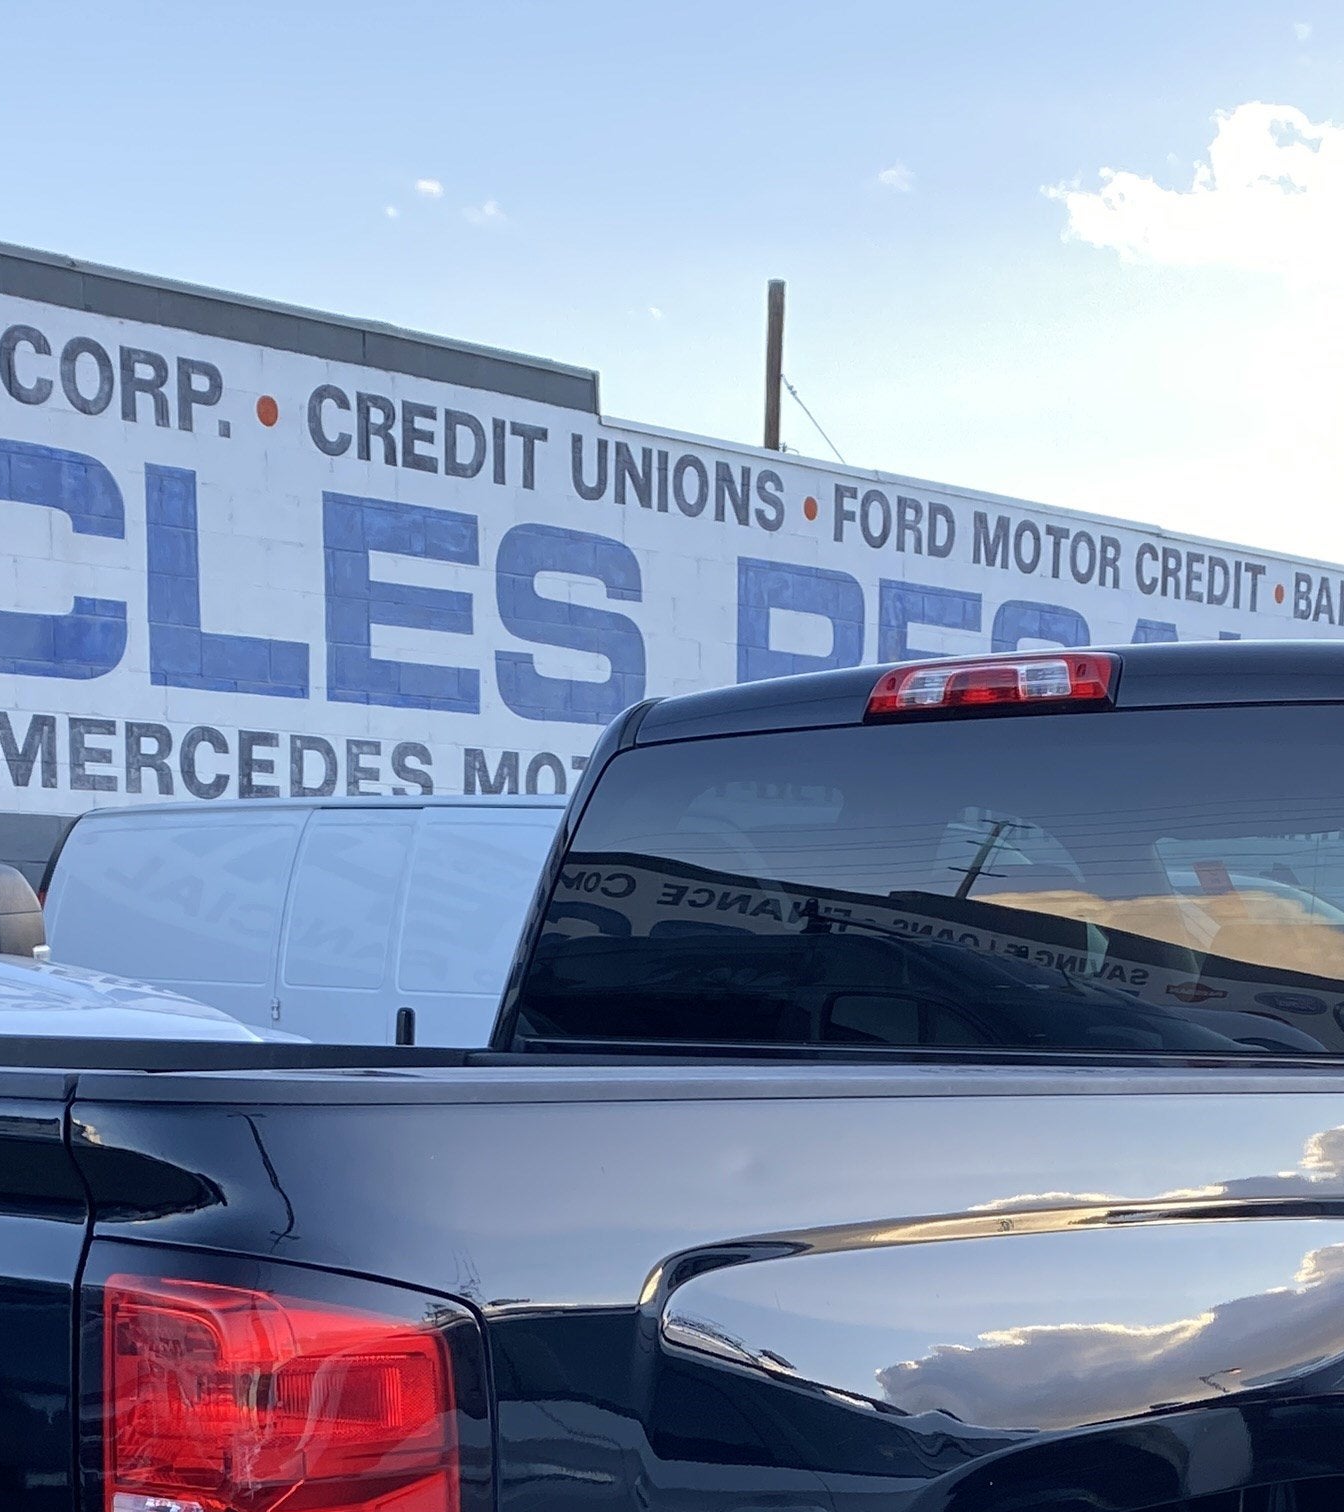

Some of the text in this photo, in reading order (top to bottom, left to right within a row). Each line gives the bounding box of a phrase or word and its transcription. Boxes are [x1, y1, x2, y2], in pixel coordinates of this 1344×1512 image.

[307, 384, 548, 490] CREDIT
[571, 433, 785, 532] UNIONS
[833, 483, 956, 559] FORD
[972, 511, 1121, 589] MOTOR
[1135, 542, 1266, 612] CREDIT
